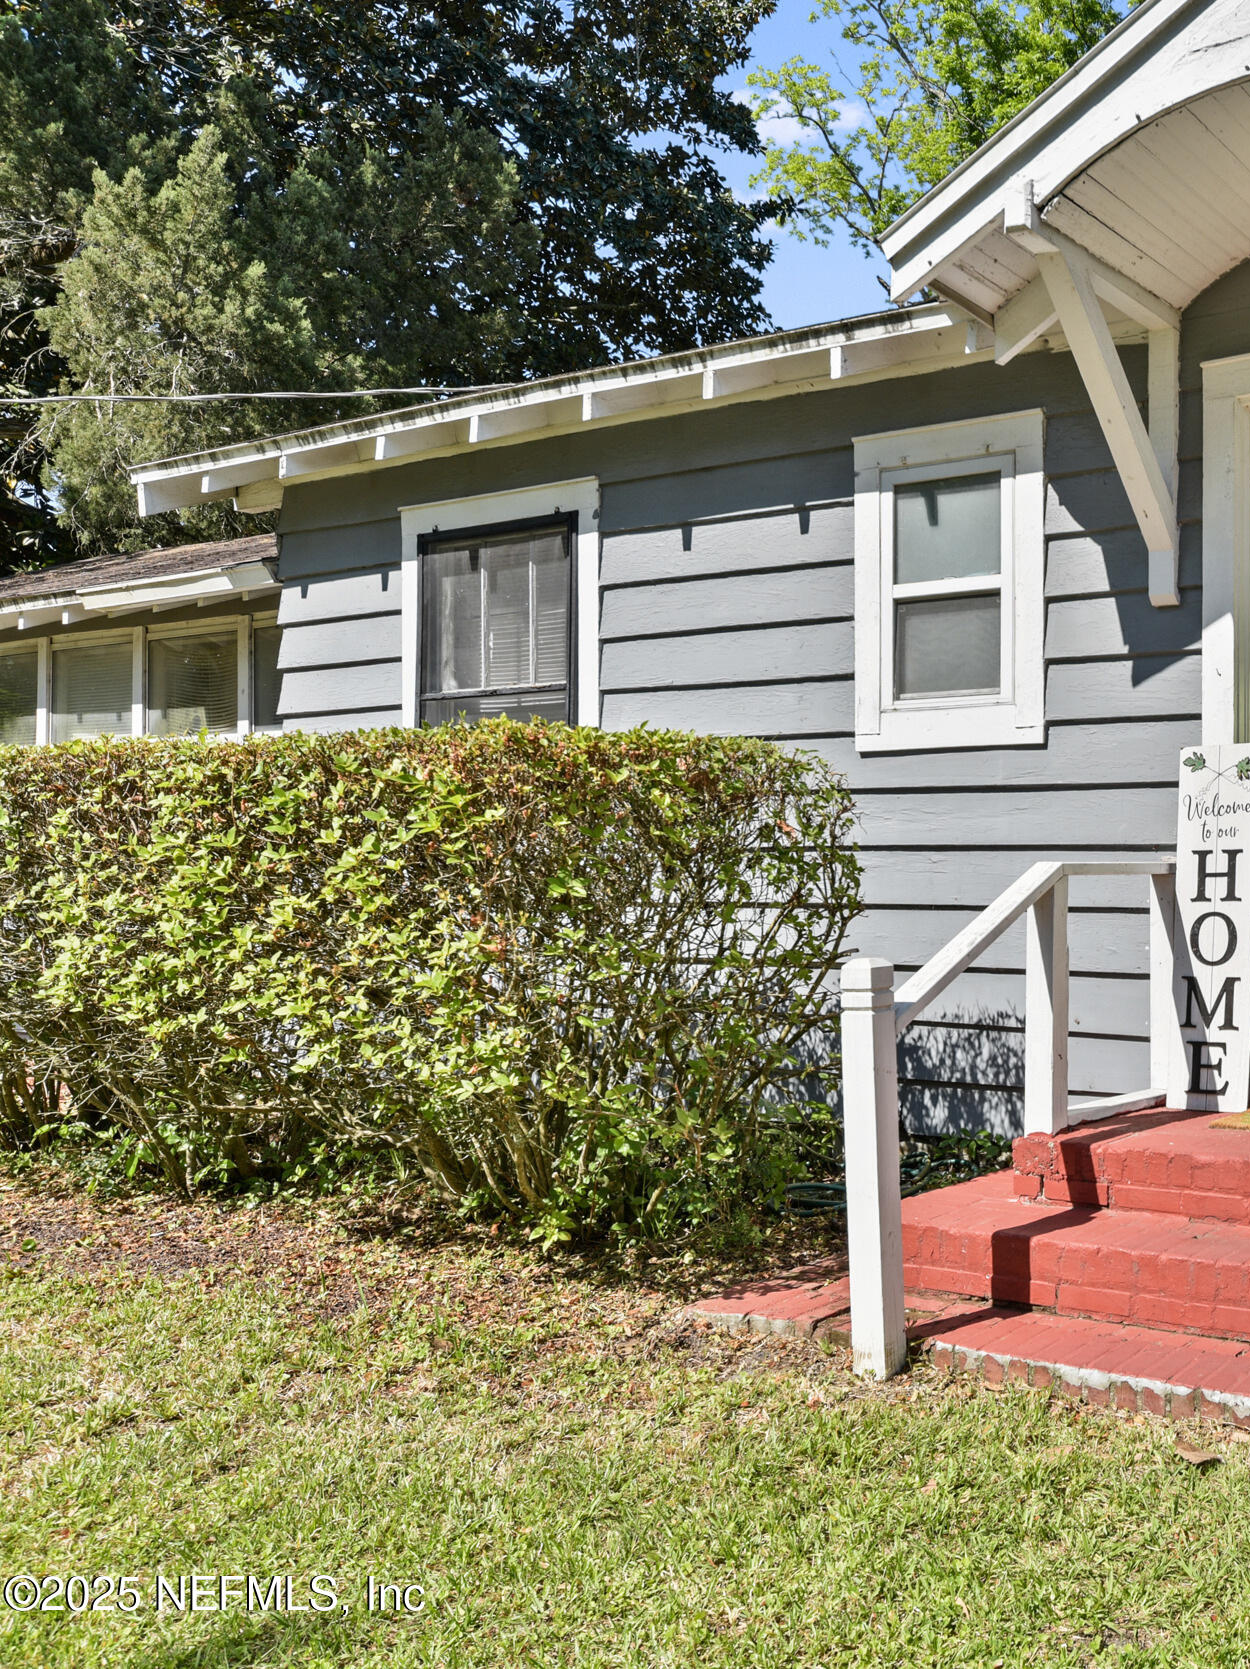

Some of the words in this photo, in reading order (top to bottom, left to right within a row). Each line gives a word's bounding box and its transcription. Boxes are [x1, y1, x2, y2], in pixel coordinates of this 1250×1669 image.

[1201, 820, 1212, 843] to
[1217, 826, 1239, 838] our
[1180, 848, 1244, 1097] HOME
